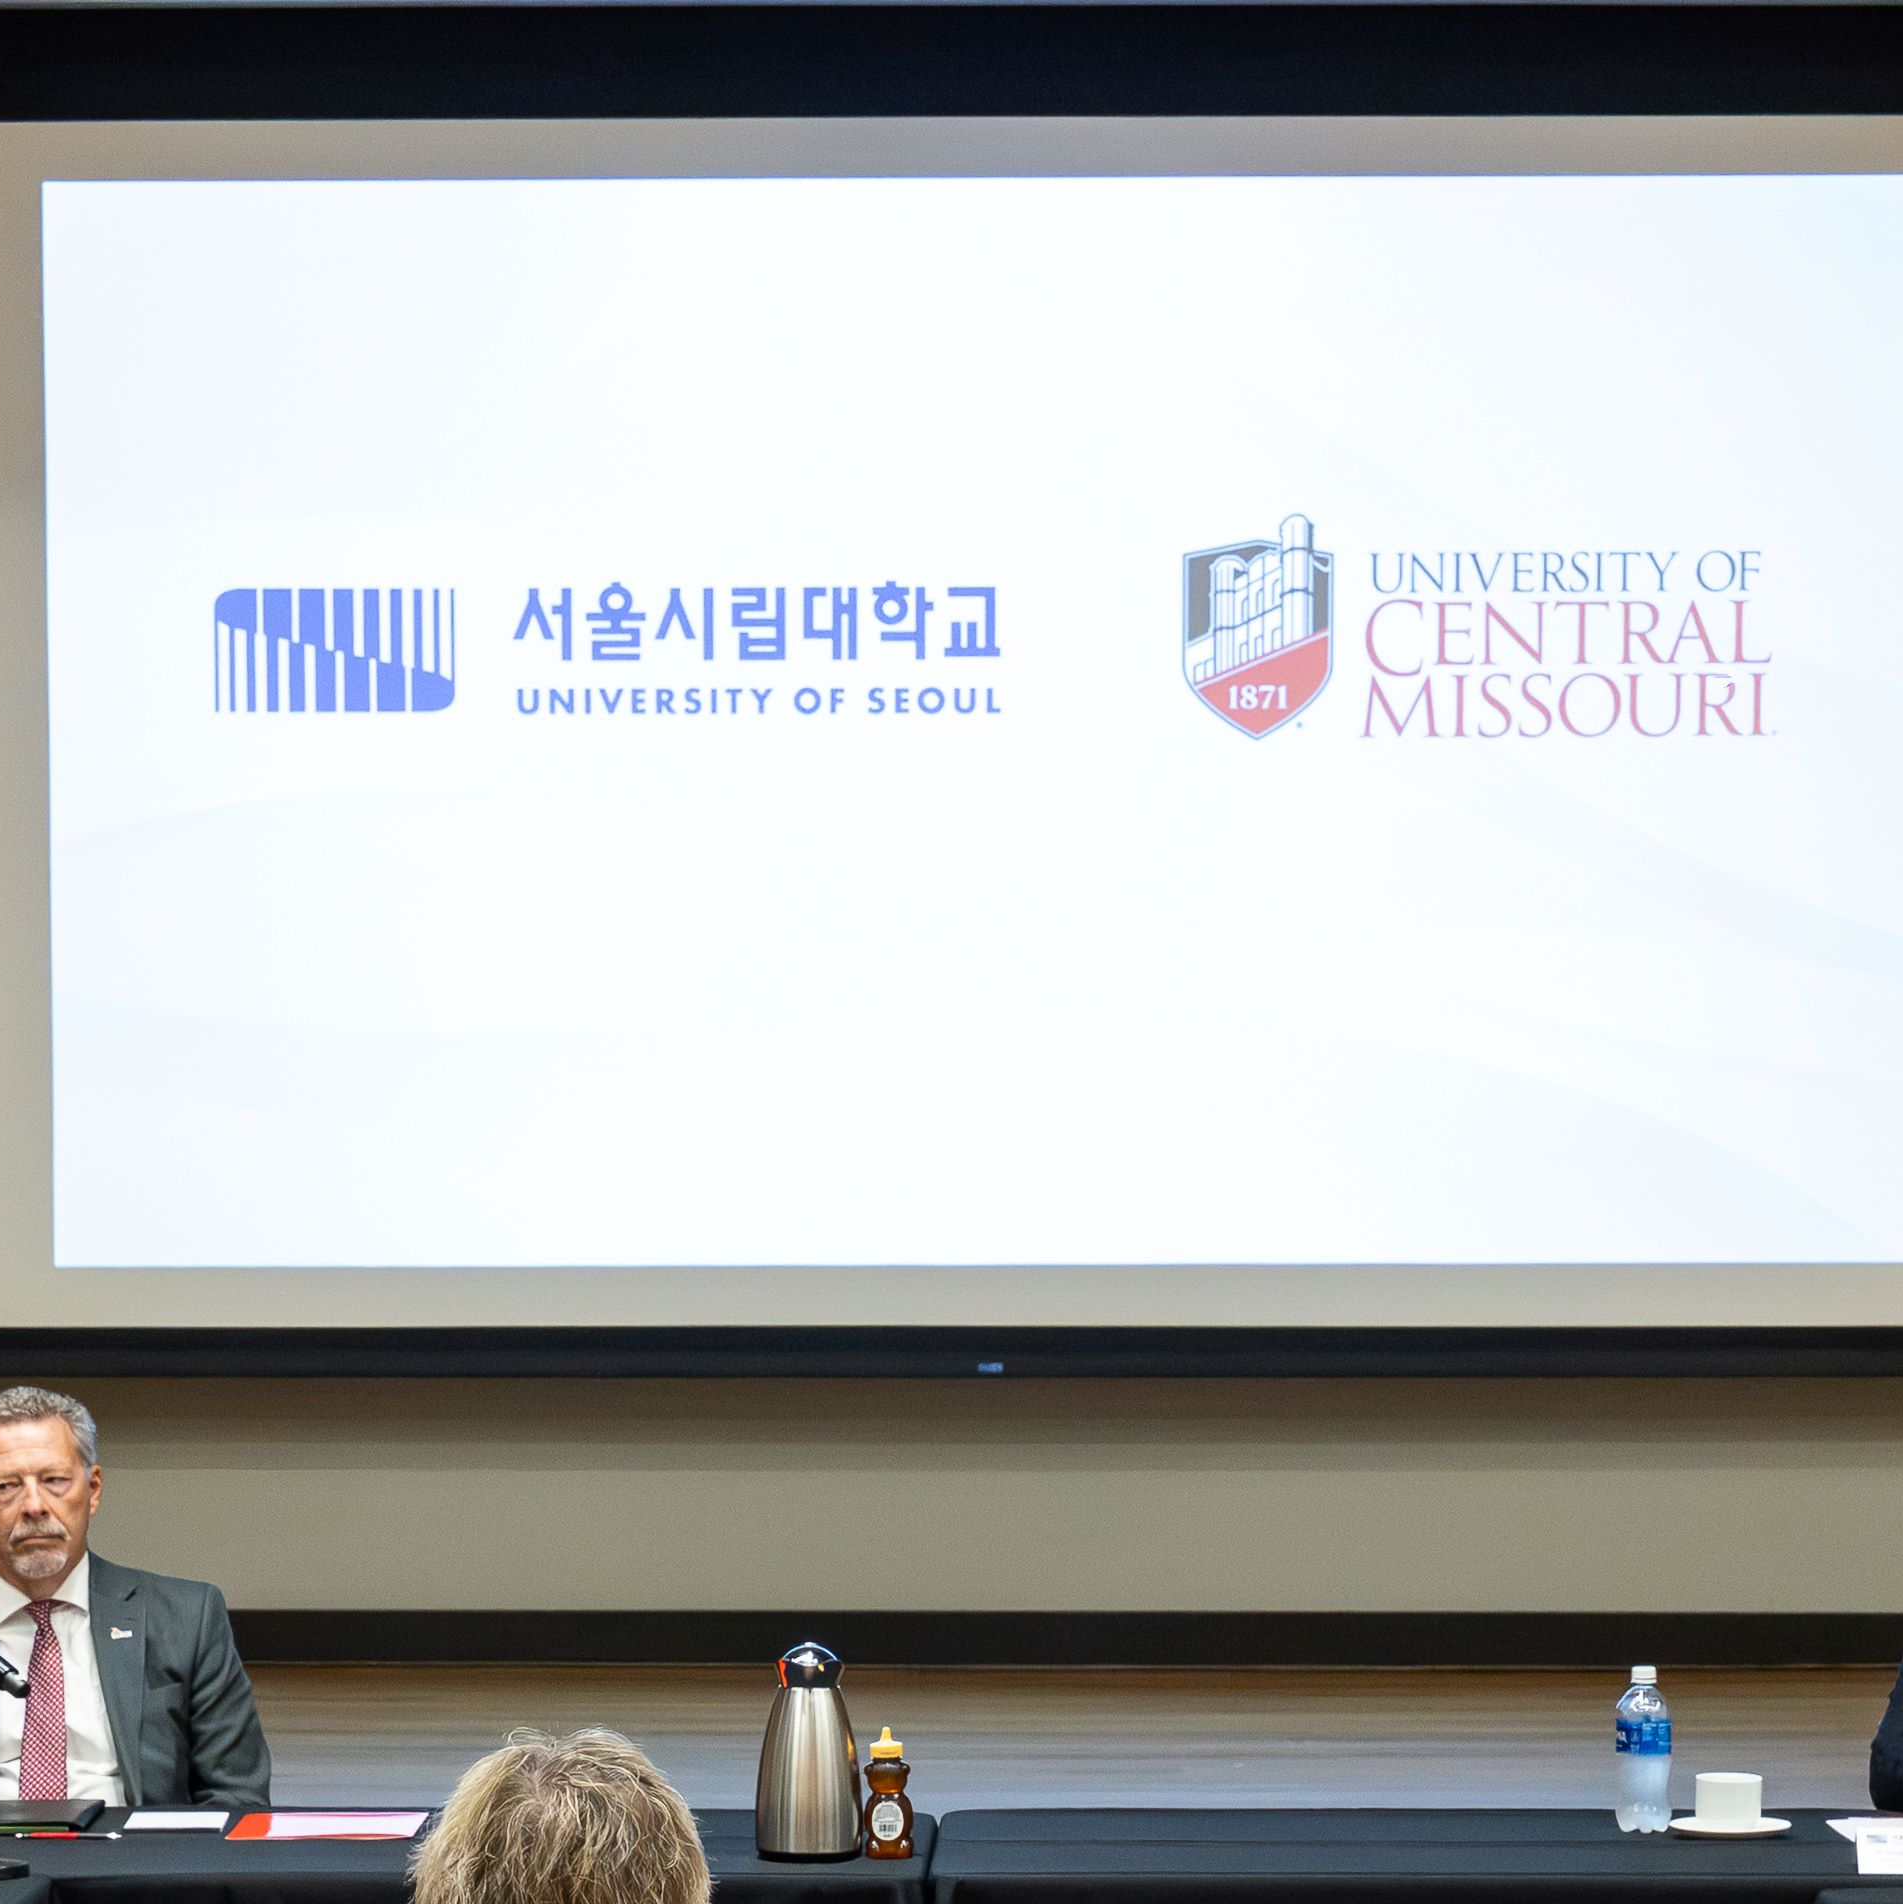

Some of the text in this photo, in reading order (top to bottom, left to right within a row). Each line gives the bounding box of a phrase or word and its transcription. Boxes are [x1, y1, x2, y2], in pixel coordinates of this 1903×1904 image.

[1370, 549, 1762, 594] UNIVERSITY OF
[511, 579, 1002, 663] 서울시립대학교
[1365, 599, 1773, 677] CENTRAL
[515, 685, 1003, 717] UNIVERSITY OF SEOUL
[1228, 684, 1288, 710] 1871
[1361, 672, 1770, 738] MISSOURI
